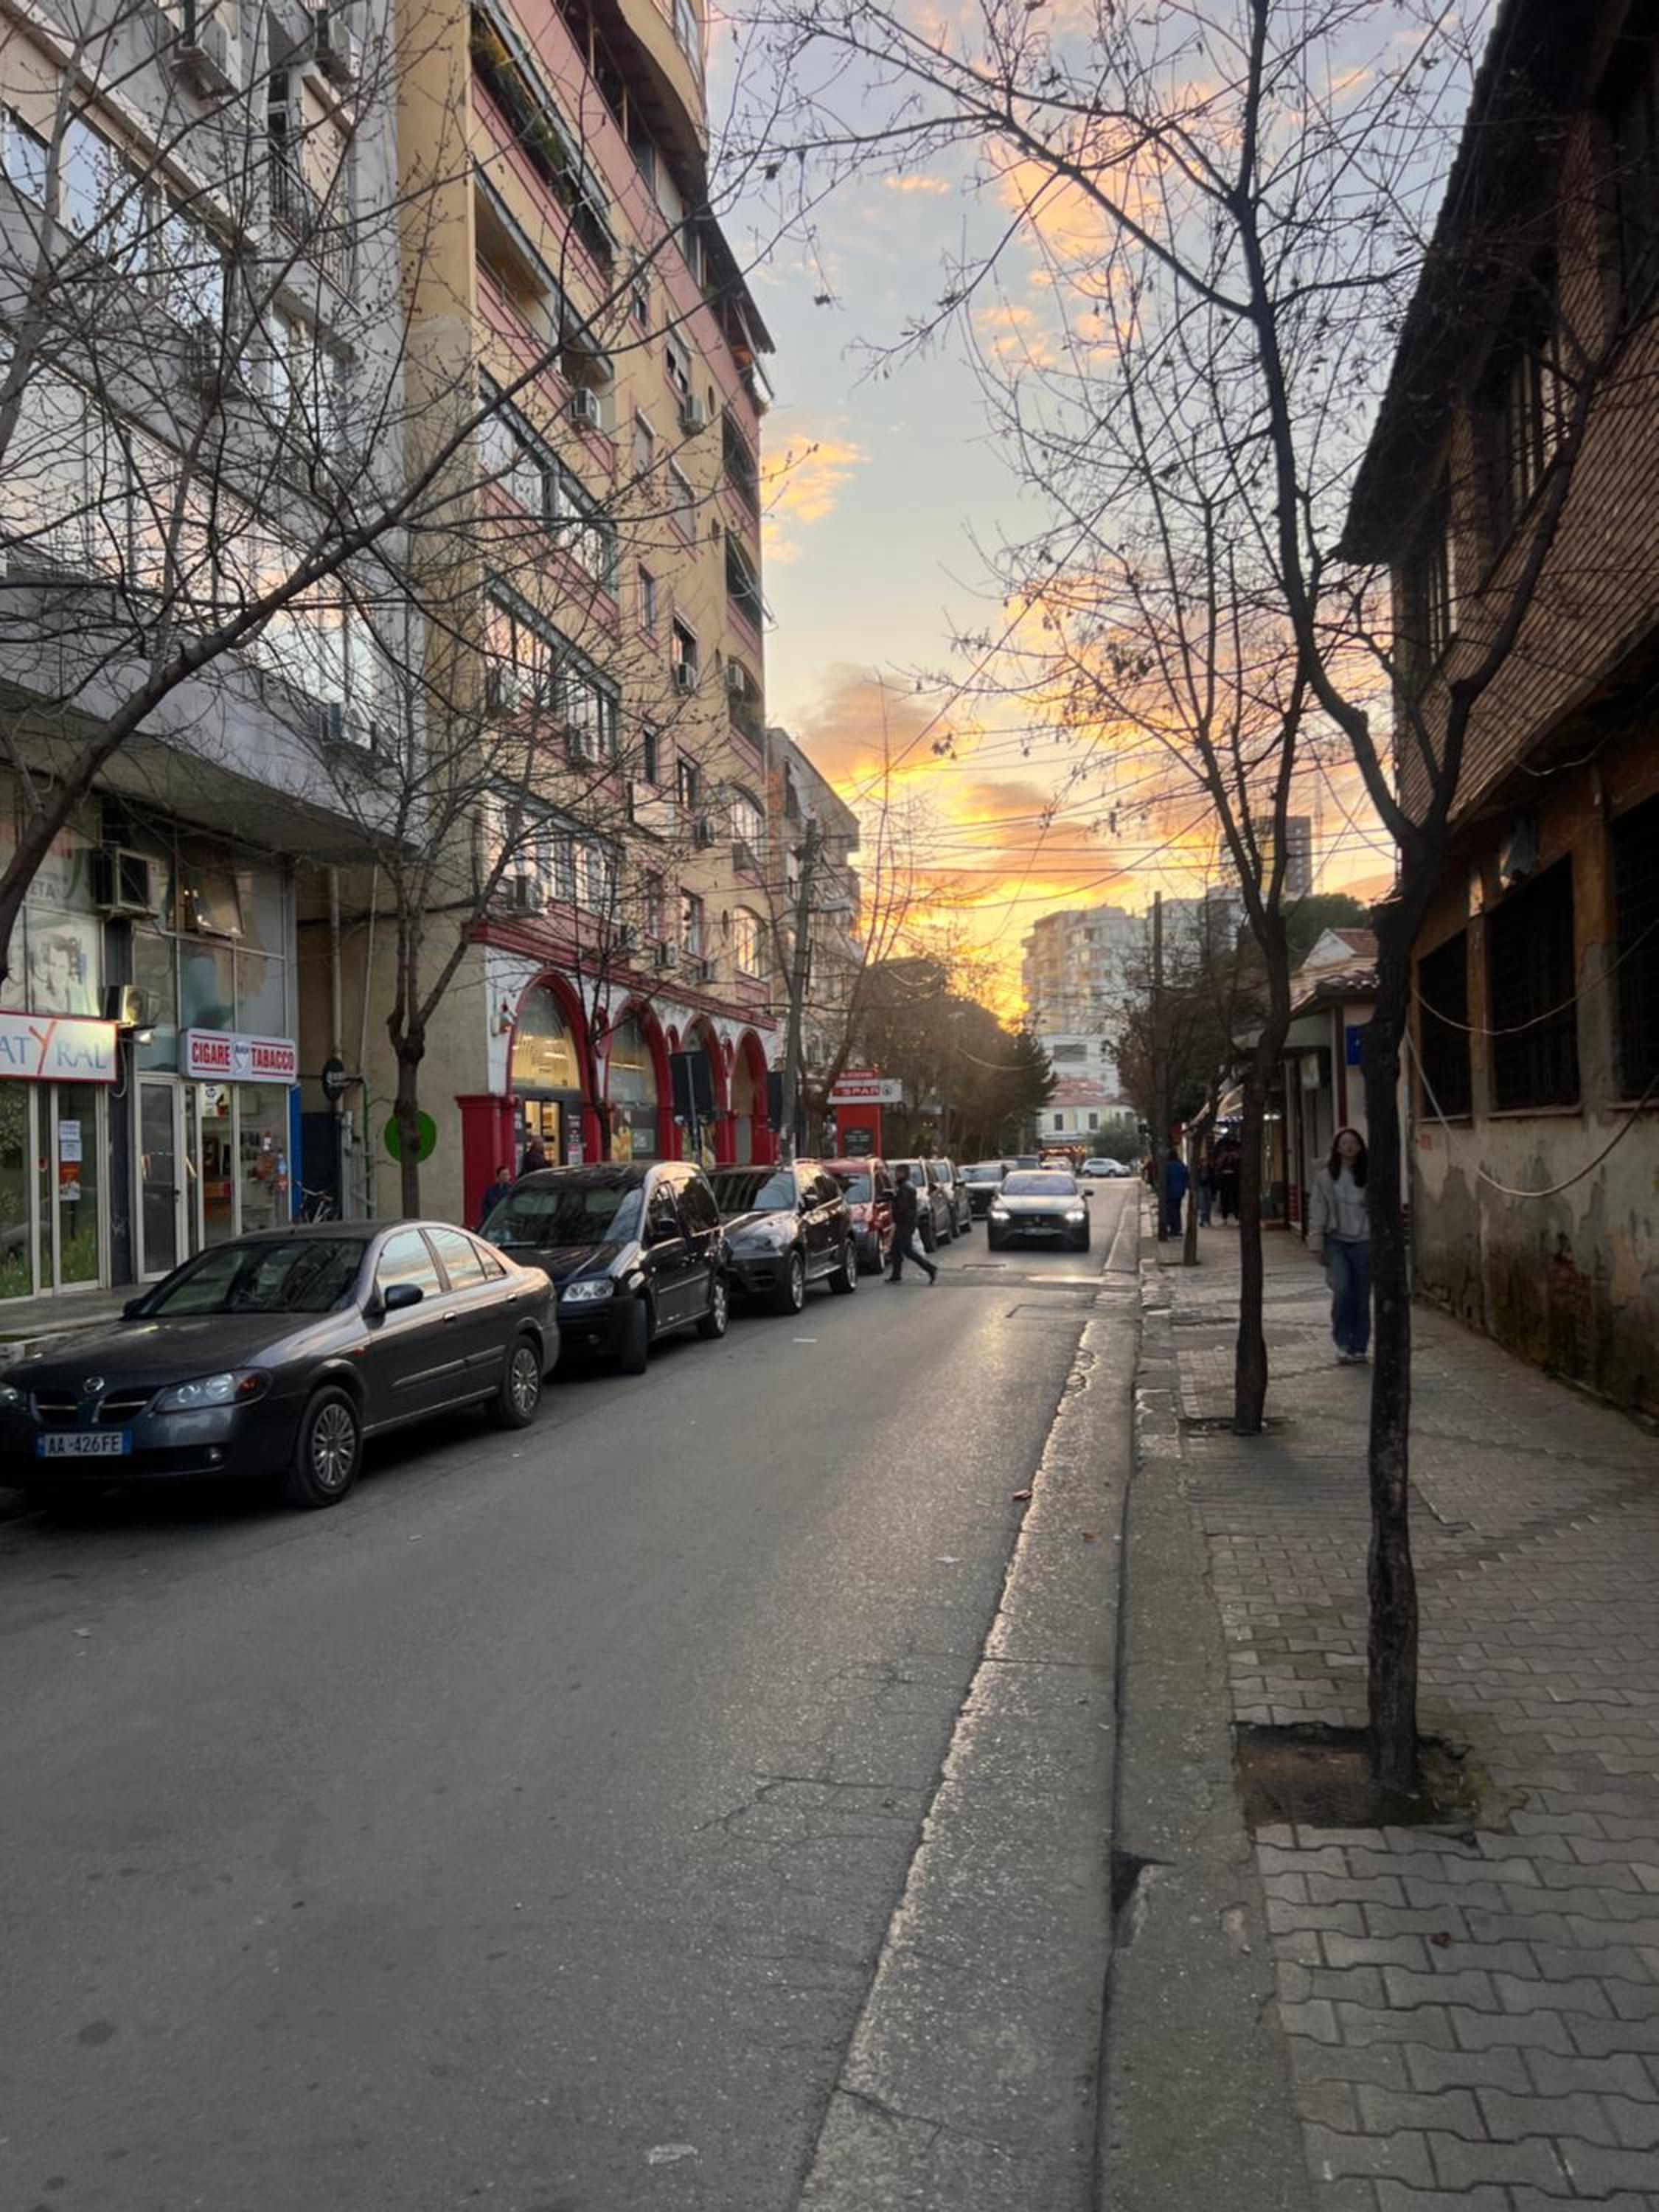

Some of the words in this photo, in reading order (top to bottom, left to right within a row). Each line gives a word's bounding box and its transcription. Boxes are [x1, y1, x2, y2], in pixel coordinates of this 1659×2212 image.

[192, 1042, 230, 1066] CIGARE
[251, 1047, 293, 1070] TABACCO
[843, 1087, 880, 1096] SPAR
